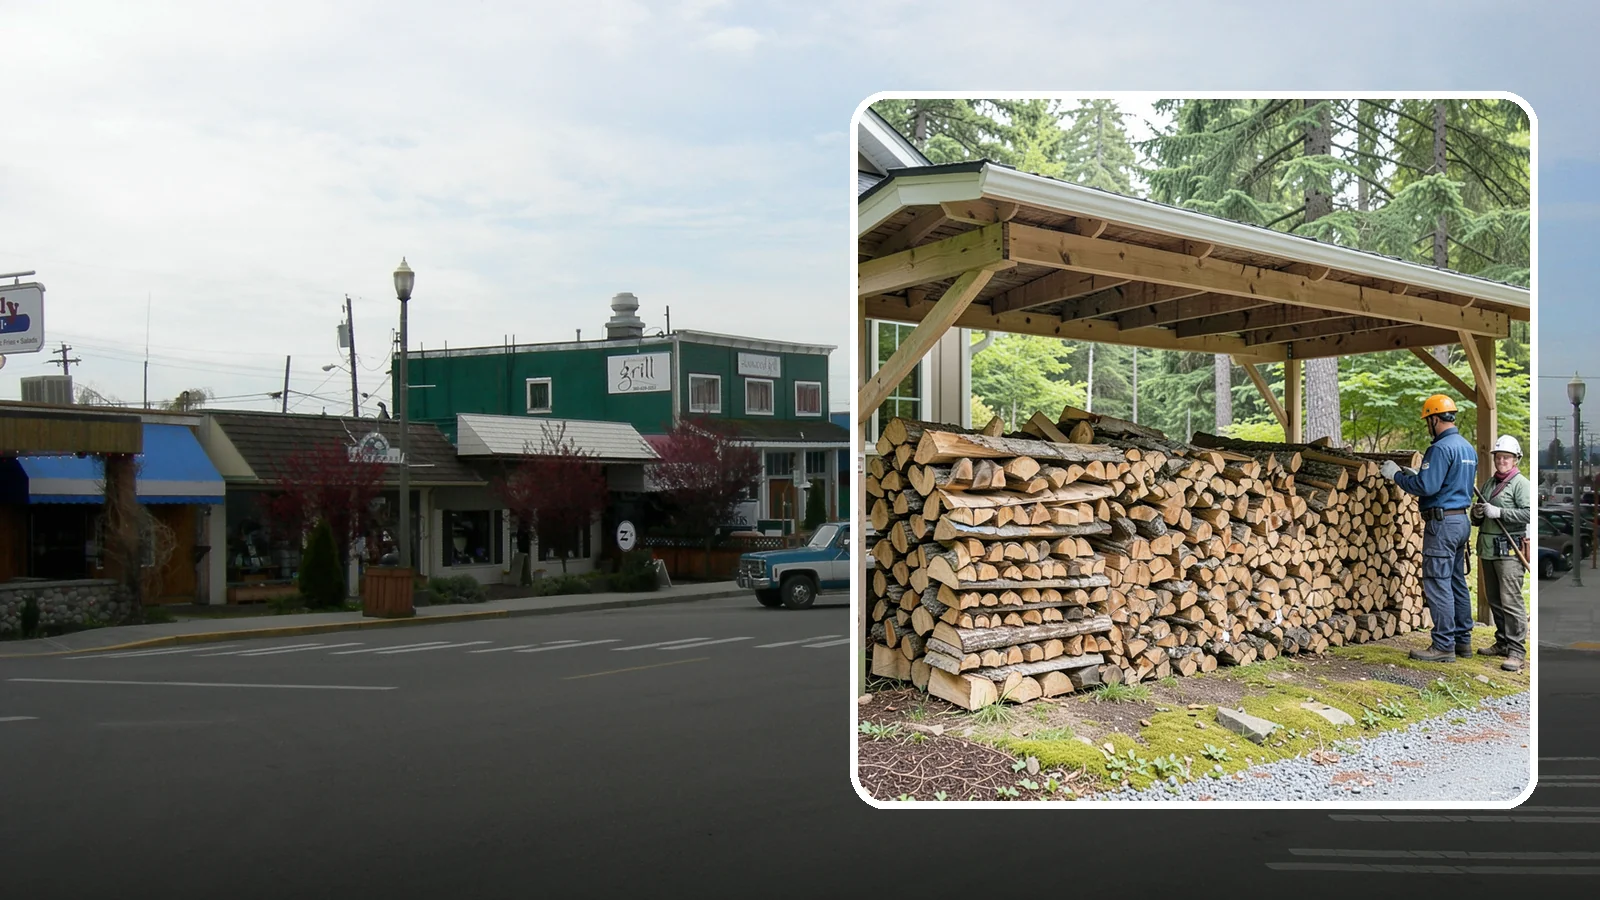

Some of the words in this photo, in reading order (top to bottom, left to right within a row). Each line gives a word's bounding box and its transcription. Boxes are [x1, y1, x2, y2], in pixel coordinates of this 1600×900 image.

[0, 296, 20, 325] ly
[20, 337, 38, 345] Salads
[618, 355, 655, 391] grill
